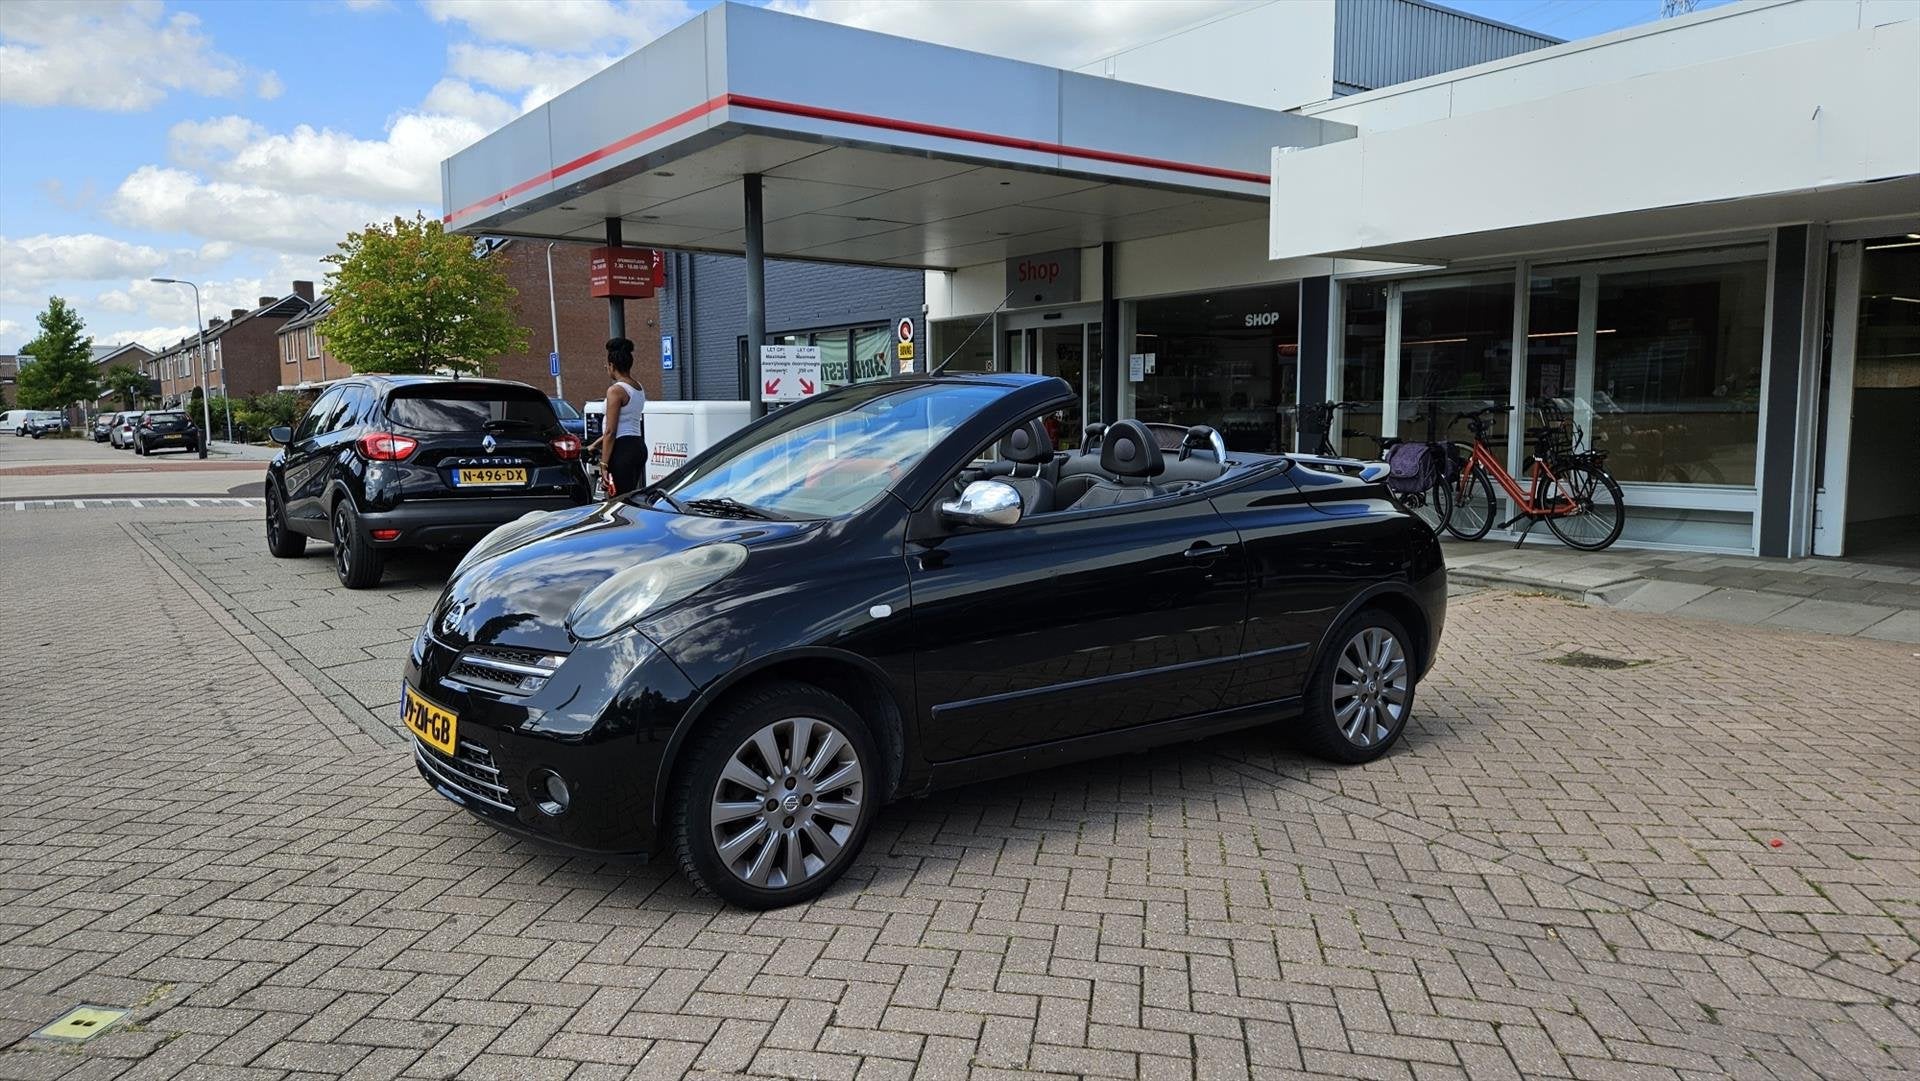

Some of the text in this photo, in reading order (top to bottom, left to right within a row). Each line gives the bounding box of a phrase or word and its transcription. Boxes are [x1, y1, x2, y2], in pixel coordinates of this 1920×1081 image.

[1018, 260, 1060, 284] Shop
[1244, 312, 1279, 327] SHOP
[462, 469, 524, 482] N-496-DX
